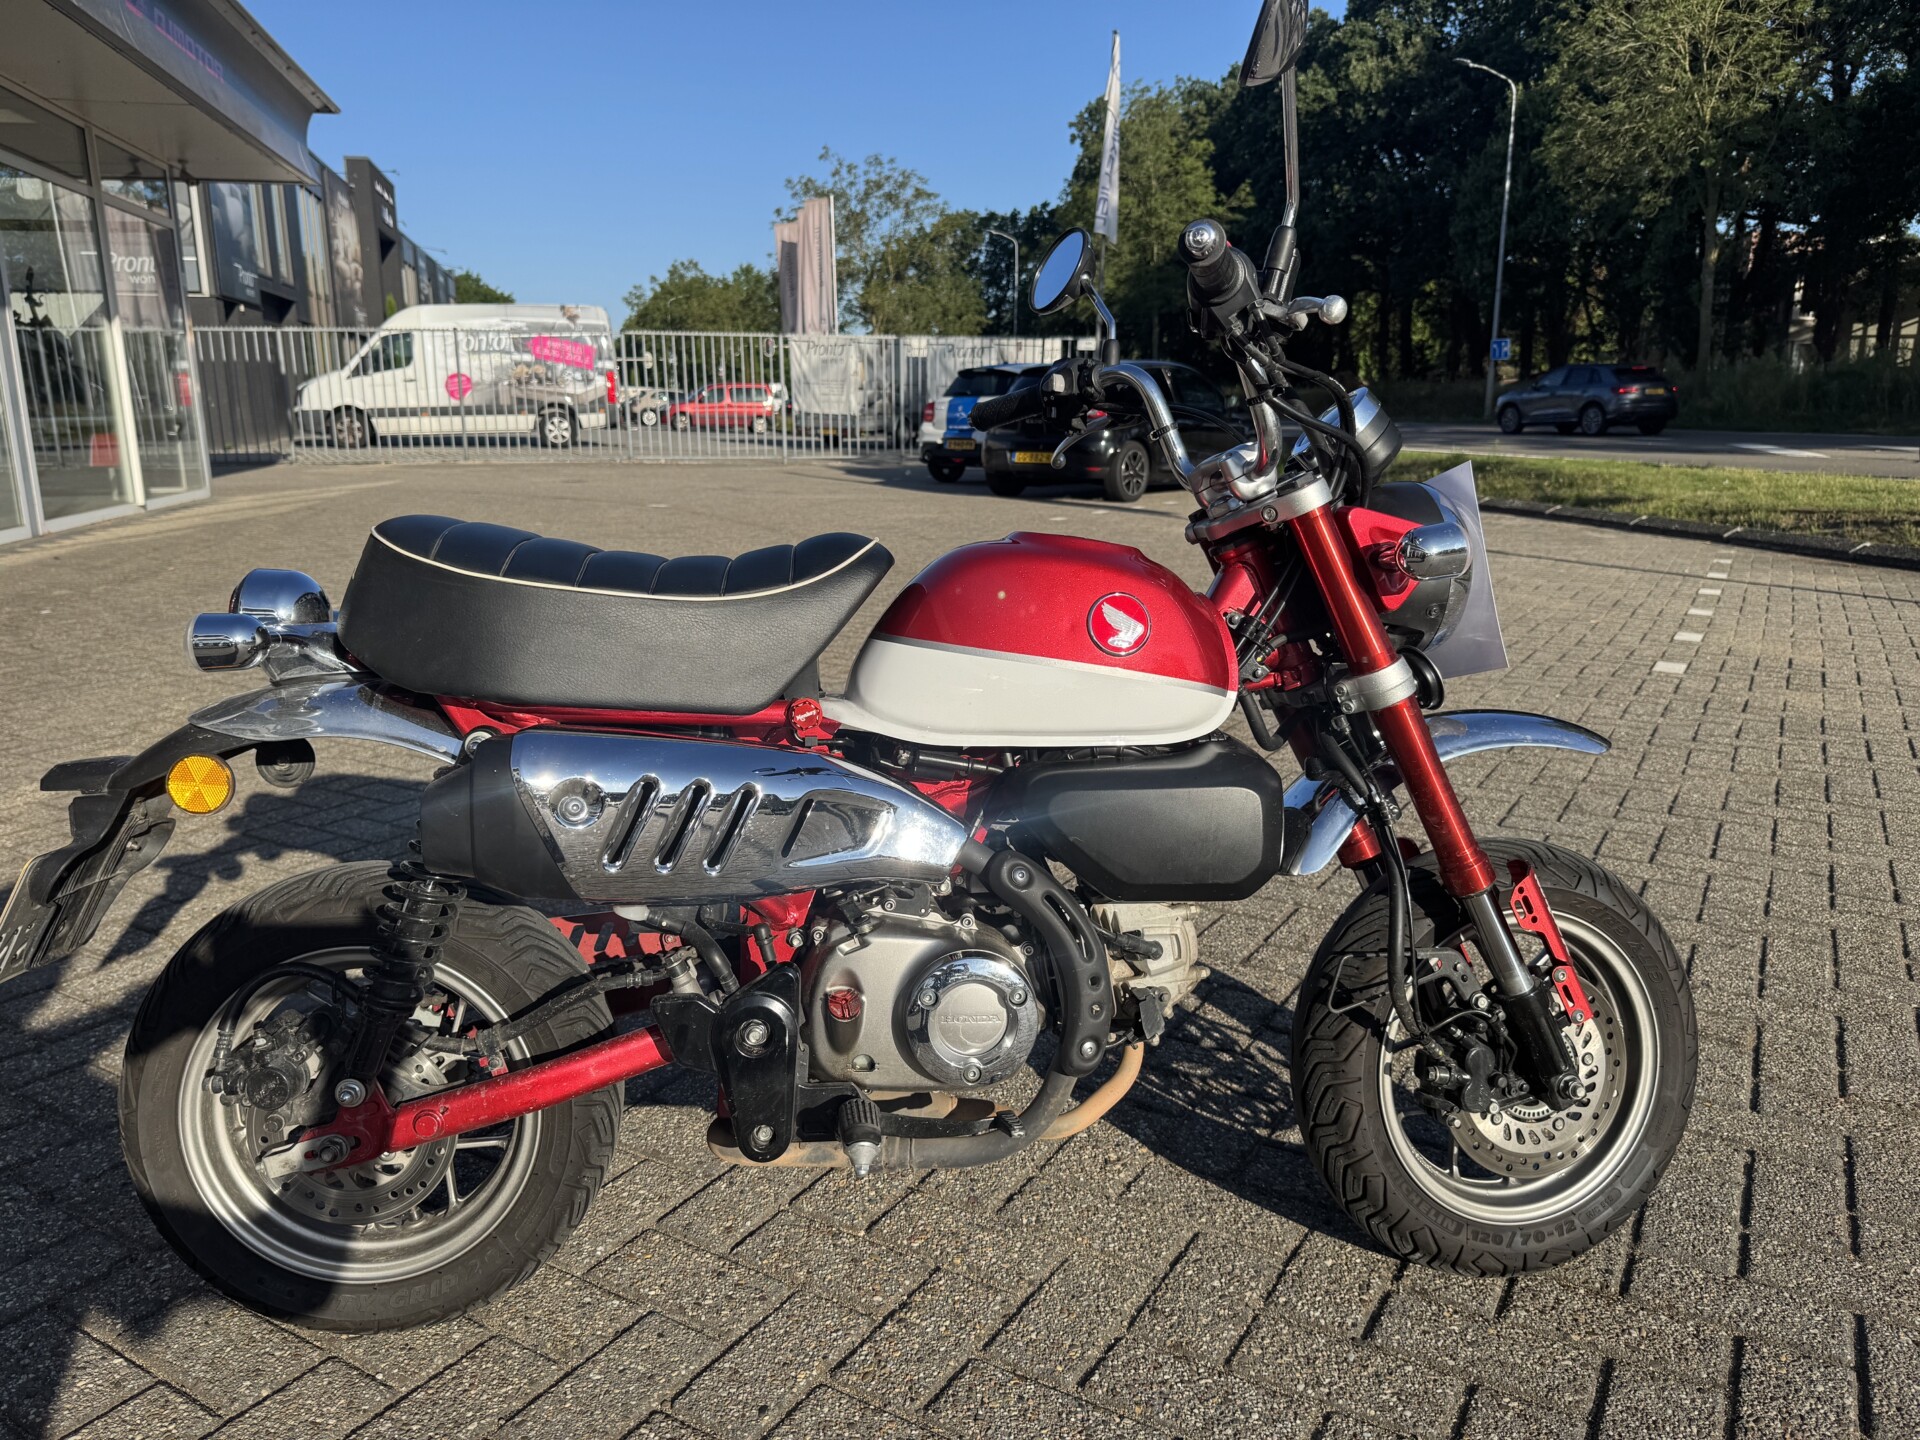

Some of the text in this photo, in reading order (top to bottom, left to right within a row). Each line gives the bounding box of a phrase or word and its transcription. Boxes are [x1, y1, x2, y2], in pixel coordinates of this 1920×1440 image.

[941, 1015, 1001, 1024] HONDA
[1385, 1159, 1459, 1233] MICHELIN
[1471, 1219, 1577, 1248] 120/70-12
[389, 1273, 459, 1309] GRIP
